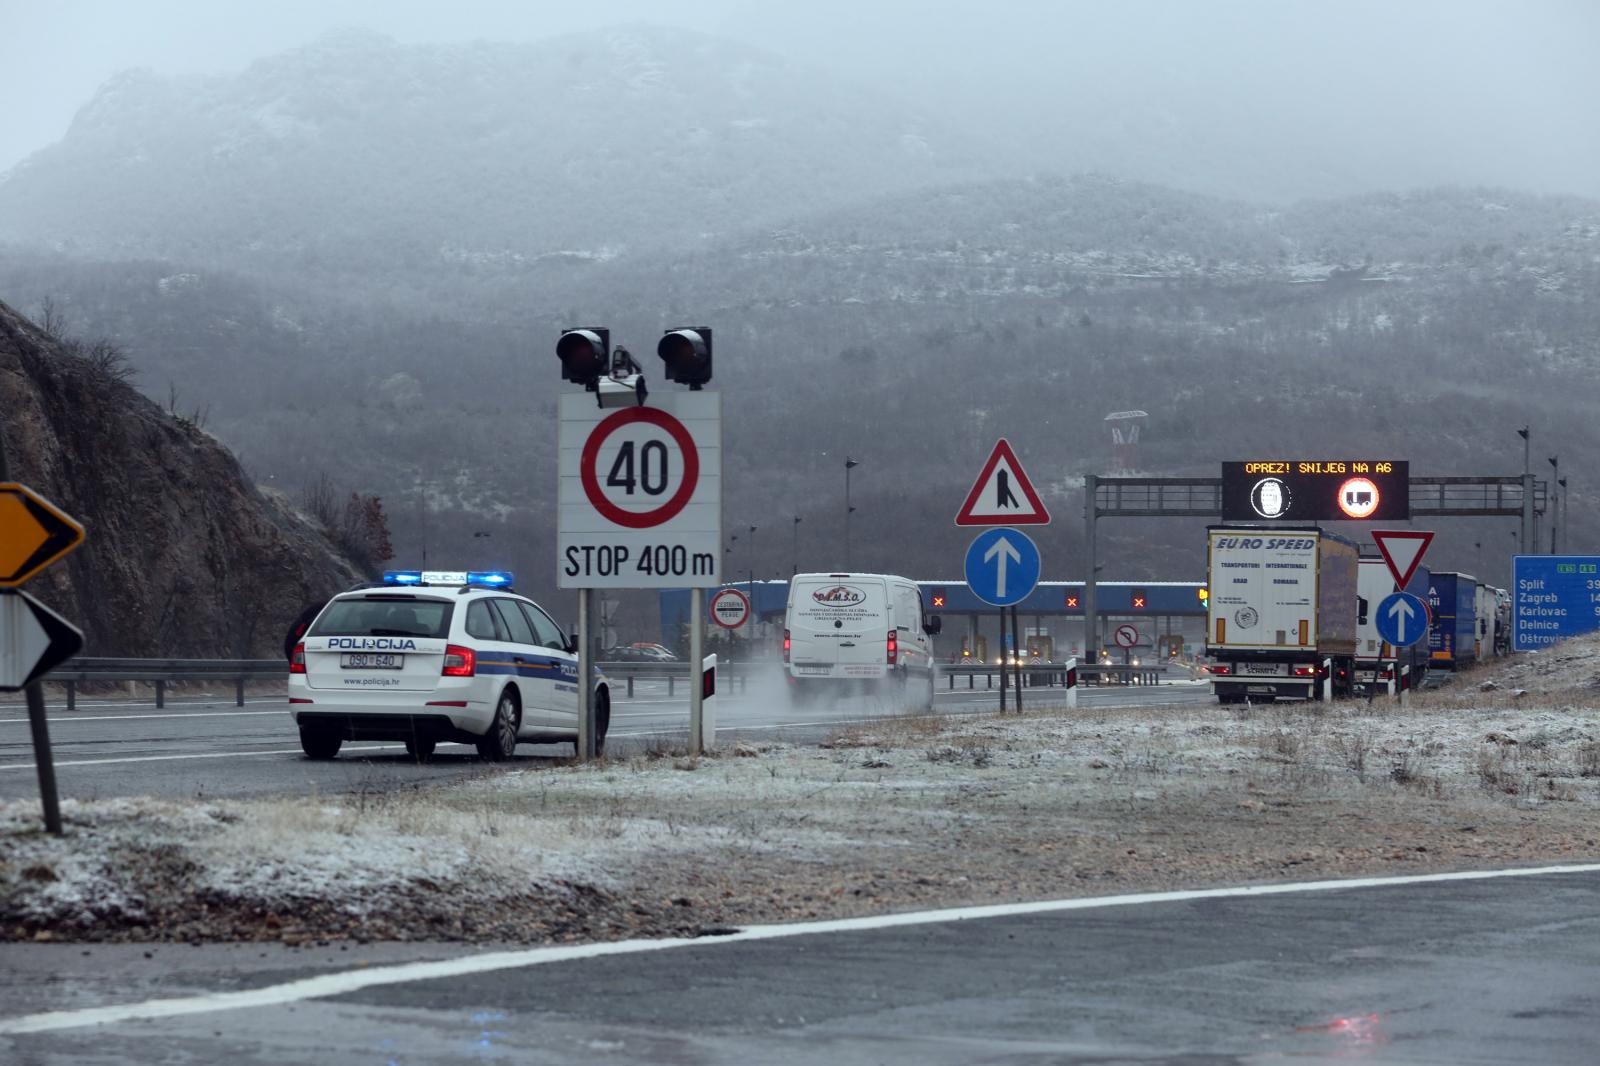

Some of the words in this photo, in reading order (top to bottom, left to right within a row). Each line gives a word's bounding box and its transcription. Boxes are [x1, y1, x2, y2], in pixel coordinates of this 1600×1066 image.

[606, 439, 669, 496] 40
[1245, 462, 1290, 474] OPREZ!
[1299, 462, 1346, 474] SNIJEG
[1352, 462, 1369, 474] NA
[1375, 462, 1392, 474] A6
[1266, 538, 1315, 550] SPEED
[565, 545, 629, 577] STOP
[636, 545, 687, 576] 400
[692, 552, 714, 576] m
[1519, 579, 1545, 591] Split
[1519, 592, 1558, 605] Zagreb
[1519, 606, 1568, 616] Karlovac
[1519, 619, 1560, 630] Delnice
[328, 638, 416, 650] POLICIJA
[349, 654, 368, 666] 090
[375, 655, 395, 666] 640
[344, 678, 400, 687] www.policija.hr
